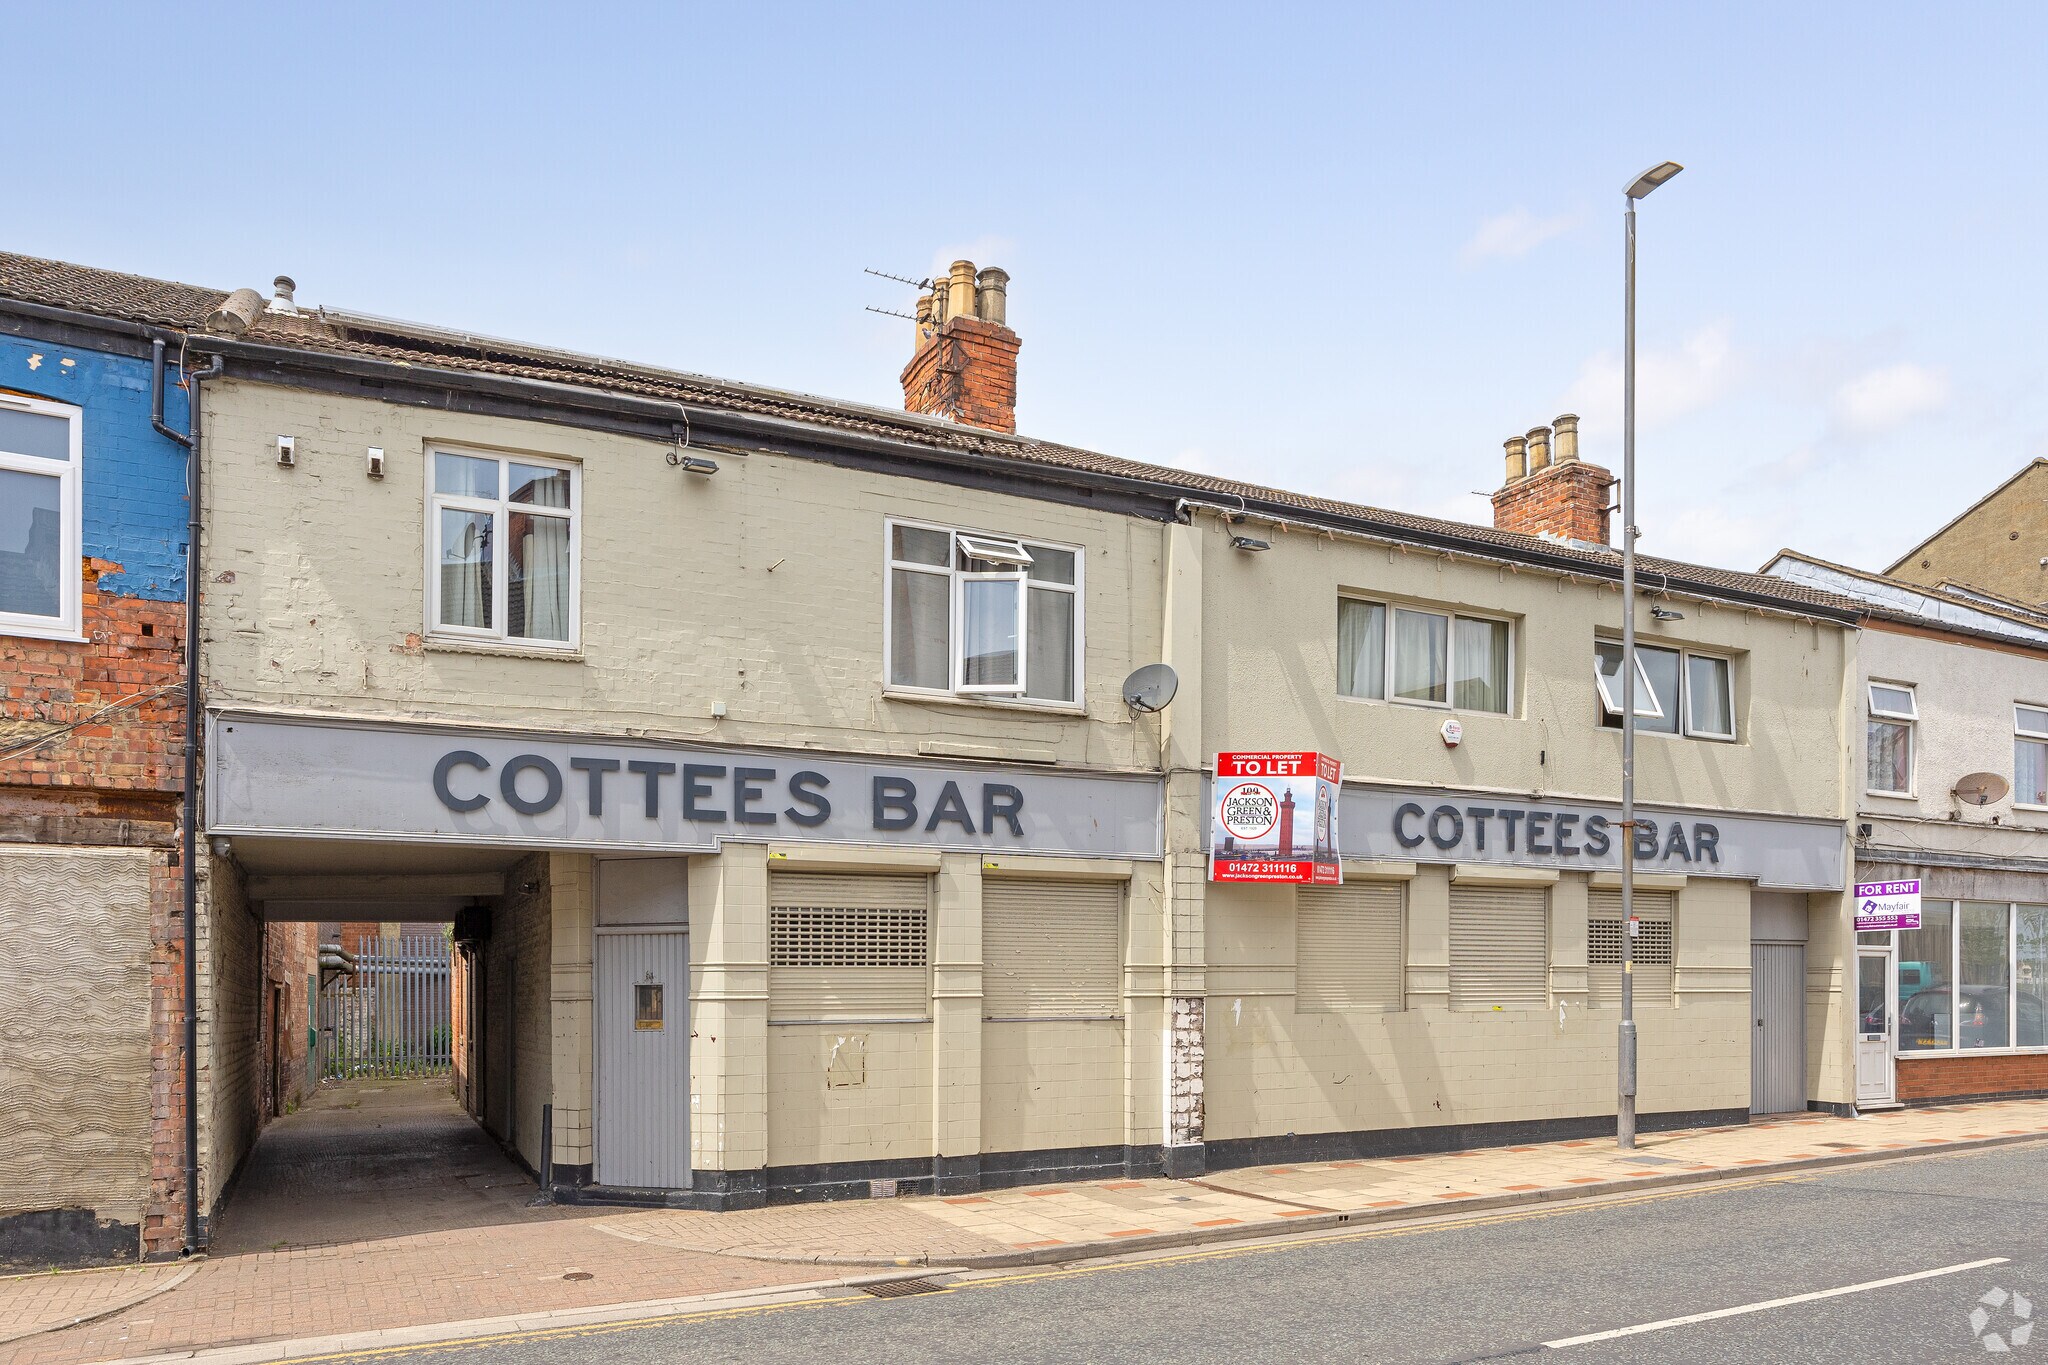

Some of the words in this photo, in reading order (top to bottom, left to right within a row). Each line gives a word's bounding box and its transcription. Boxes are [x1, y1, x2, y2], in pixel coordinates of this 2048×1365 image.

[1232, 761, 1260, 774] TO
[1266, 761, 1302, 774] LET
[432, 750, 832, 827] COTTEES
[872, 775, 1025, 837] BAR
[1226, 798, 1272, 806] JACKSON
[1227, 806, 1262, 816] GREEN
[1263, 806, 1271, 816] &
[1227, 816, 1272, 825] PRESTON
[1394, 802, 1611, 857] COTTEES
[1633, 818, 1720, 863] BAR
[1230, 864, 1258, 872] 01472
[1262, 864, 1296, 873] 311116
[1859, 885, 1882, 895] FOR
[1886, 883, 1914, 894] RENT
[1878, 902, 1910, 912] Mayfair
